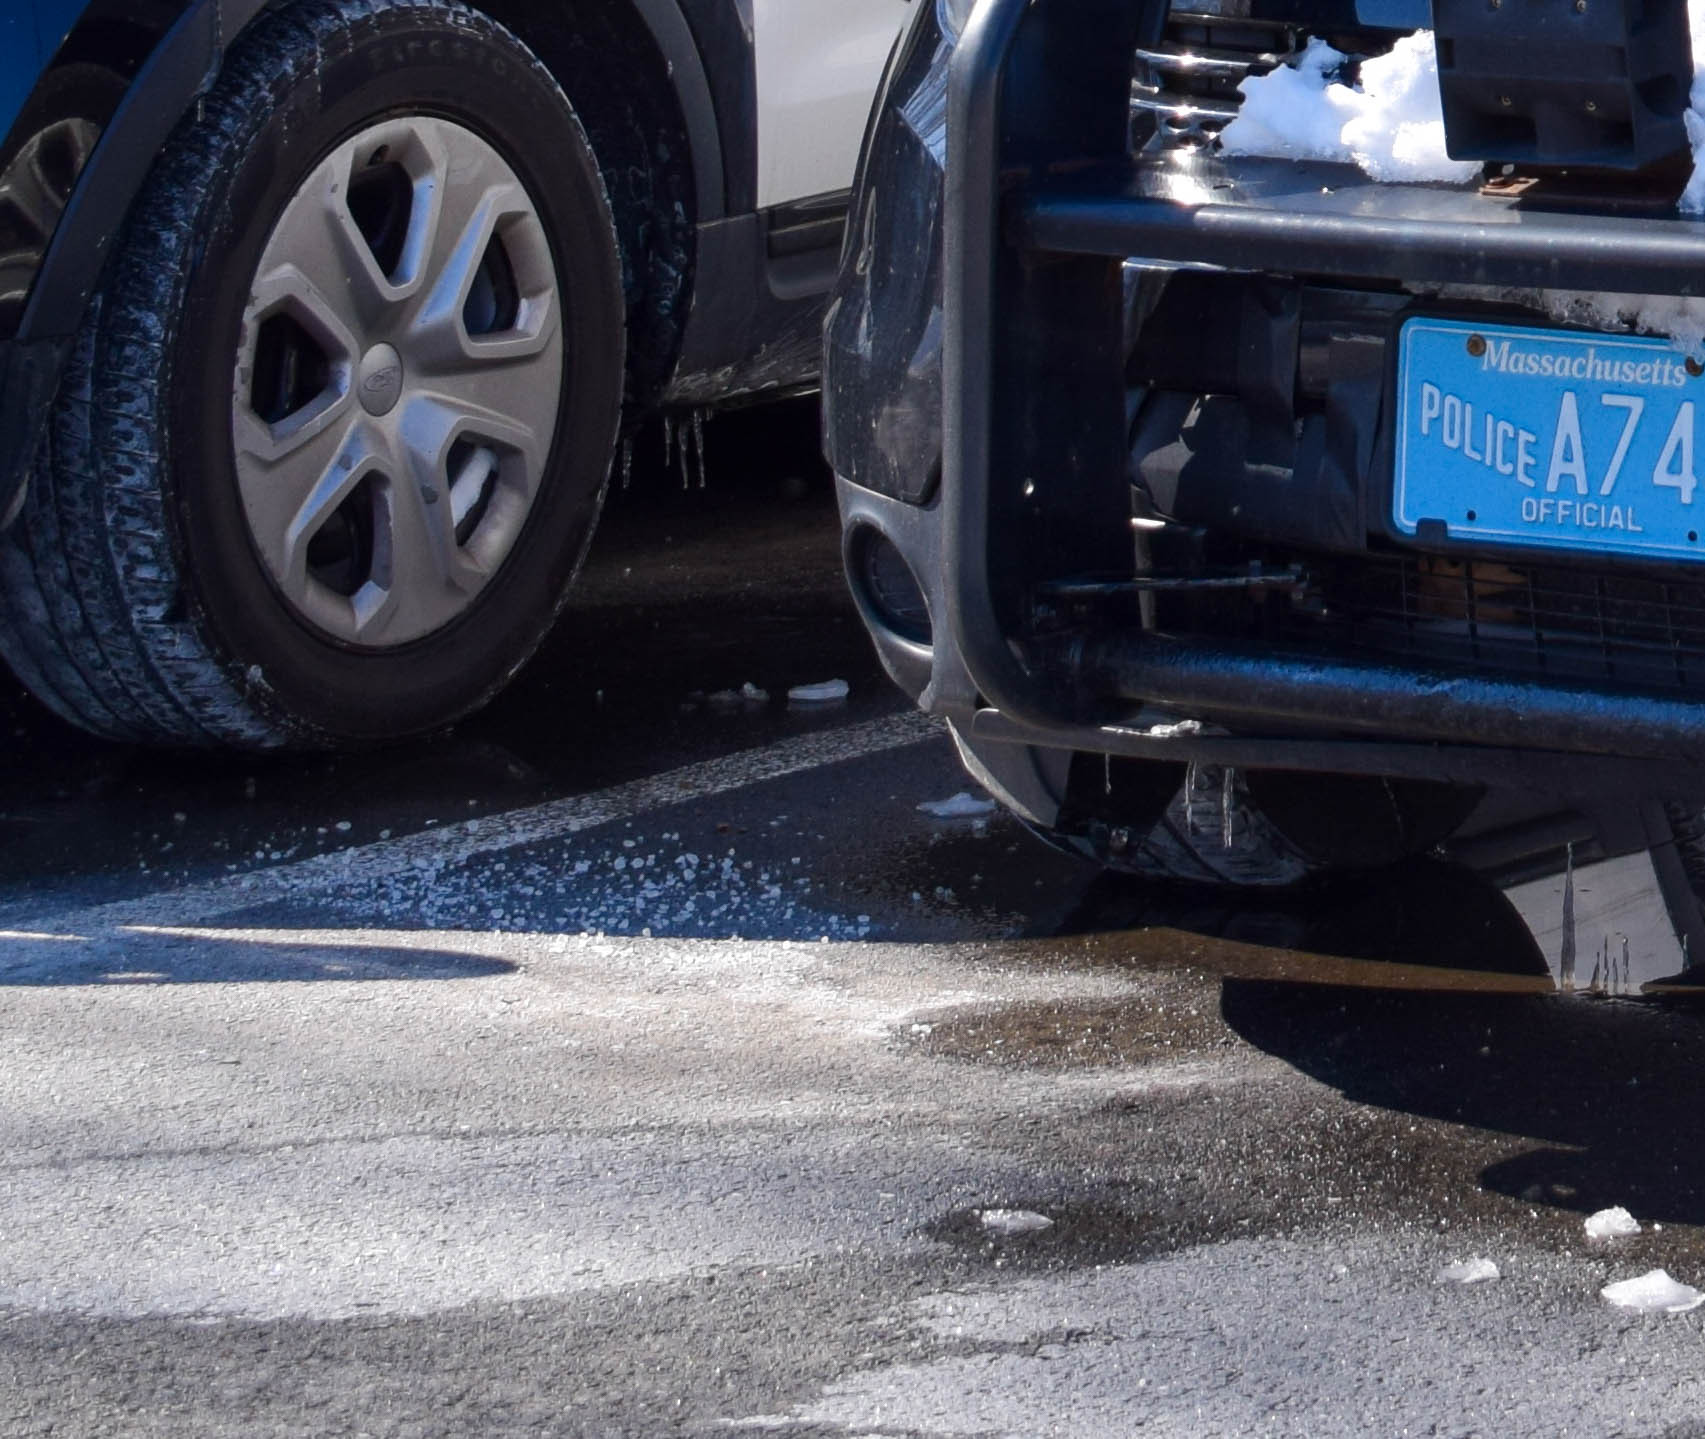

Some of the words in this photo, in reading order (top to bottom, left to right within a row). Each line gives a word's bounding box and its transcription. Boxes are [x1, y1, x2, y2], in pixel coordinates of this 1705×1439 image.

[1481, 340, 1687, 387] Massachusetts
[1421, 383, 1536, 488] POLICE
[1521, 497, 1643, 532] OFFICIAL
